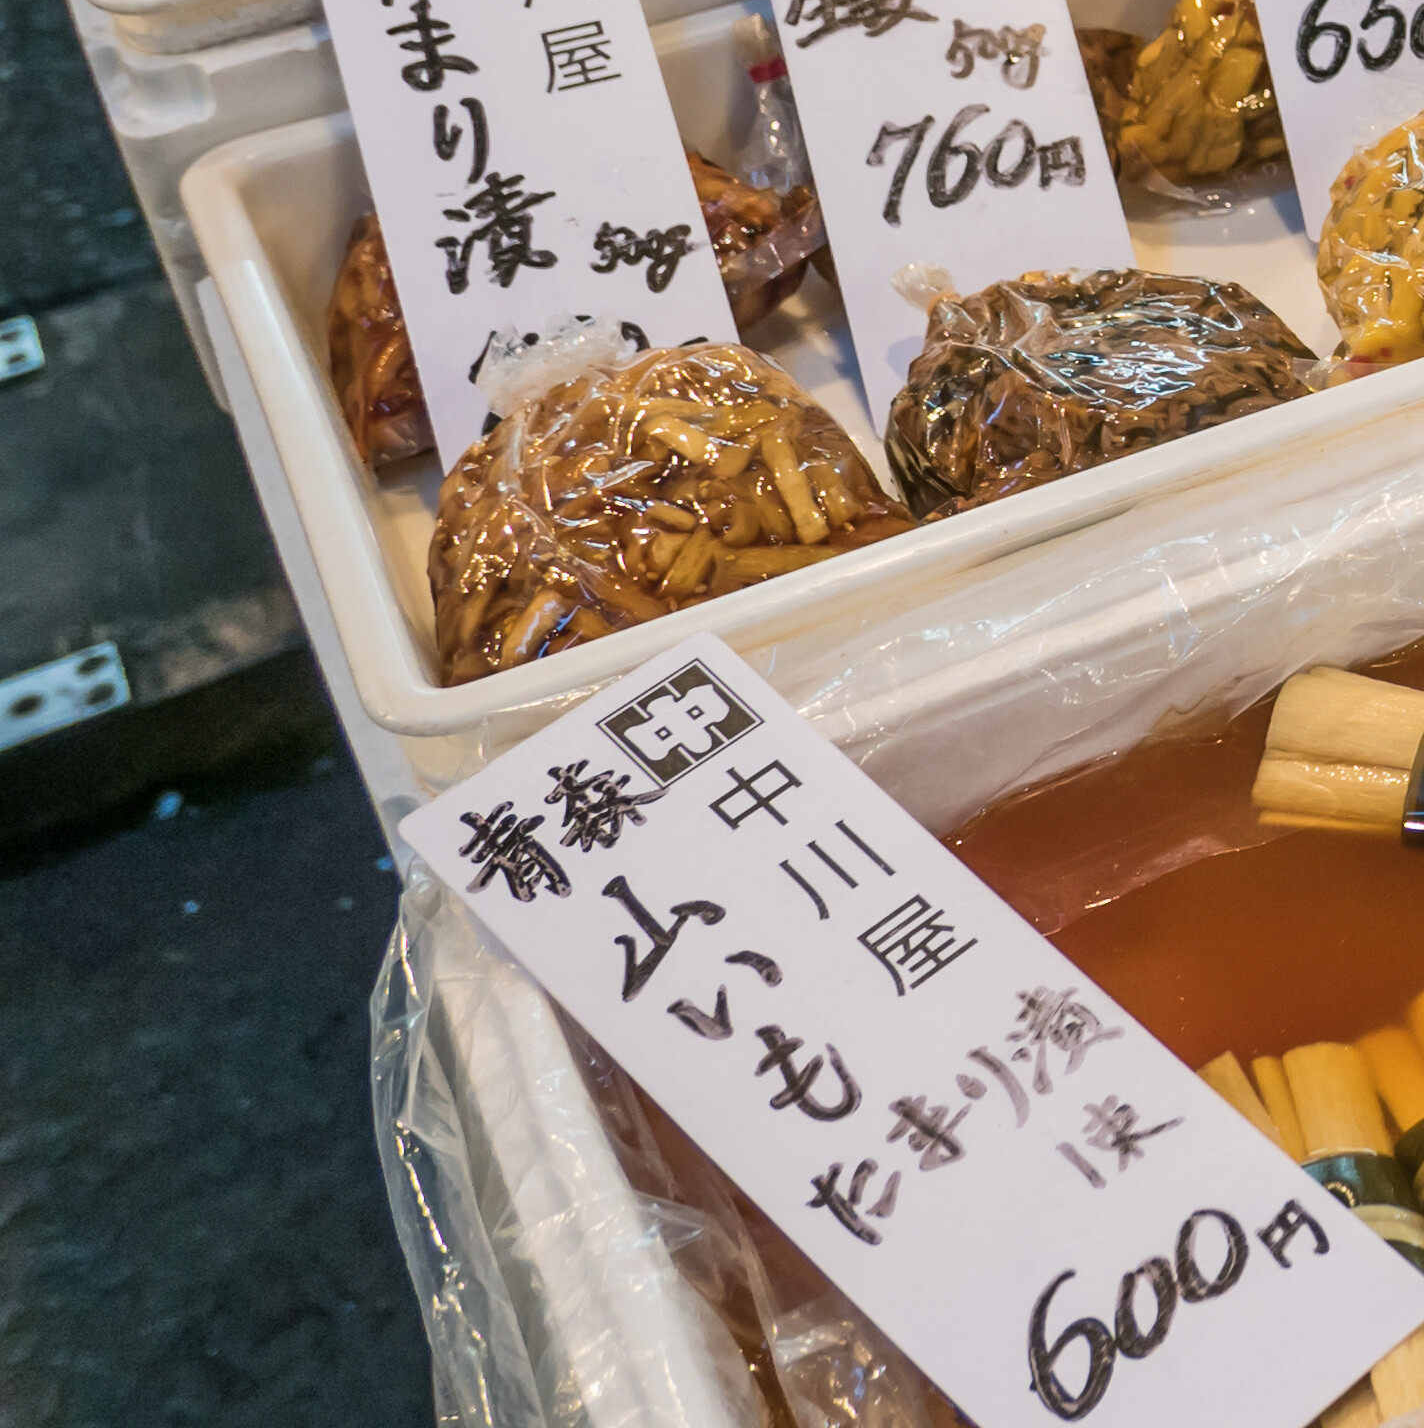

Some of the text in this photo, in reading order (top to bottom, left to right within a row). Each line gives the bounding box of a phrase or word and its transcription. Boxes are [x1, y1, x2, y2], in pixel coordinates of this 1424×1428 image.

[866, 104, 1087, 228] 760円
[458, 759, 670, 903] 青森
[709, 759, 978, 997] 中川屋
[602, 875, 862, 1121] 山いも
[806, 985, 1125, 1245] たまり漬
[1028, 1198, 1330, 1422] 600円
